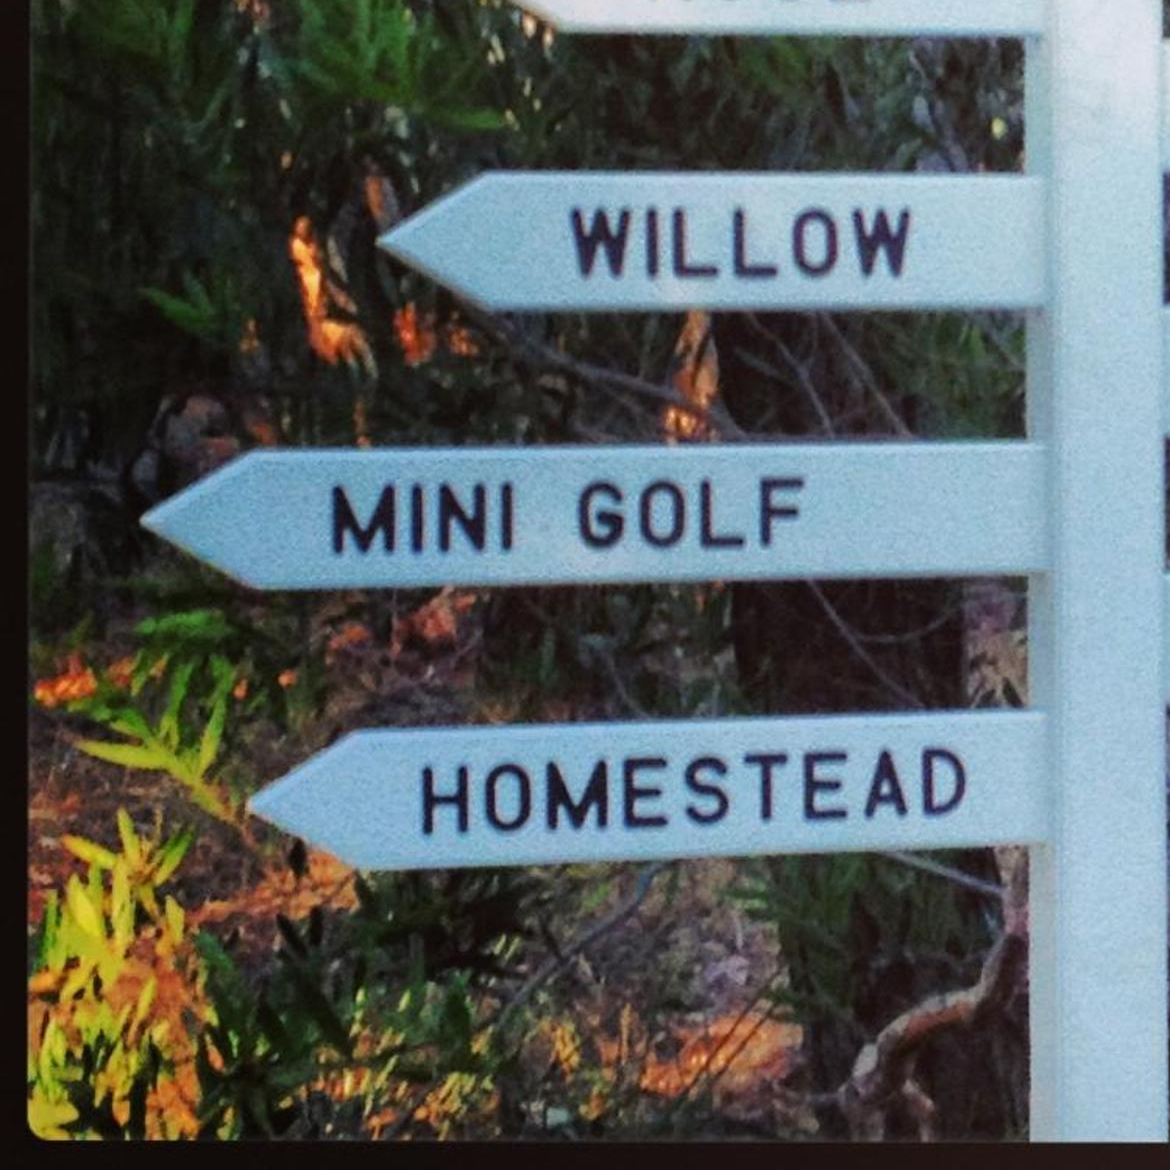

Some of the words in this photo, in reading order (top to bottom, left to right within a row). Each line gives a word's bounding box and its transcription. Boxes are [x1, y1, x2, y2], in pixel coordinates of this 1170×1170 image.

[569, 207, 909, 279] WILLOW
[332, 483, 512, 554] MINI
[577, 477, 804, 549] GOLF
[422, 748, 965, 836] HOMESTEAD
